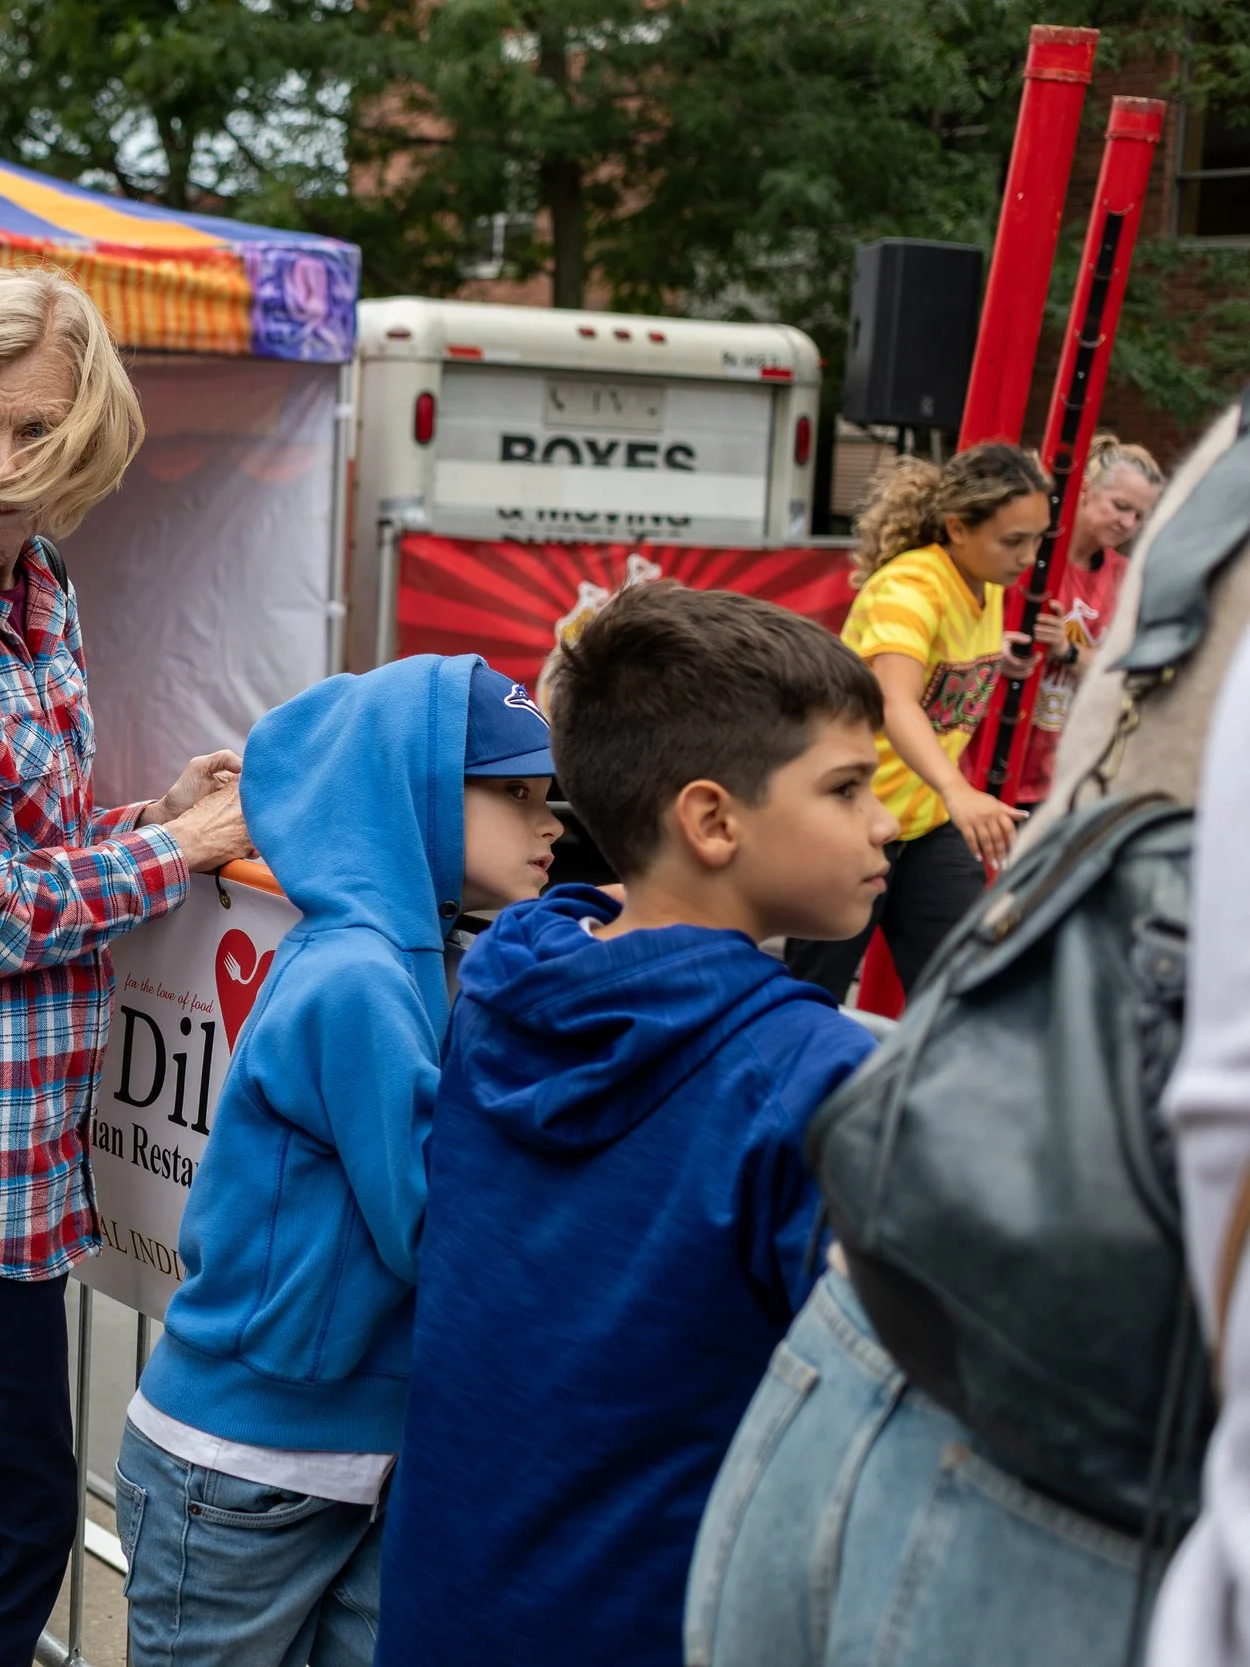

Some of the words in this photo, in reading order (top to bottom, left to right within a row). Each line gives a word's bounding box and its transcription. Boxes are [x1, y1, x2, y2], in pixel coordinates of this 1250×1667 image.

[124, 973, 140, 992] for
[140, 978, 155, 995] the
[156, 983, 177, 1001] love
[177, 991, 190, 1010] of
[190, 994, 214, 1013] food
[113, 1005, 216, 1137] Dil
[91, 1107, 125, 1160] ian
[130, 1122, 201, 1190] Resta
[128, 1228, 188, 1283] INDI
